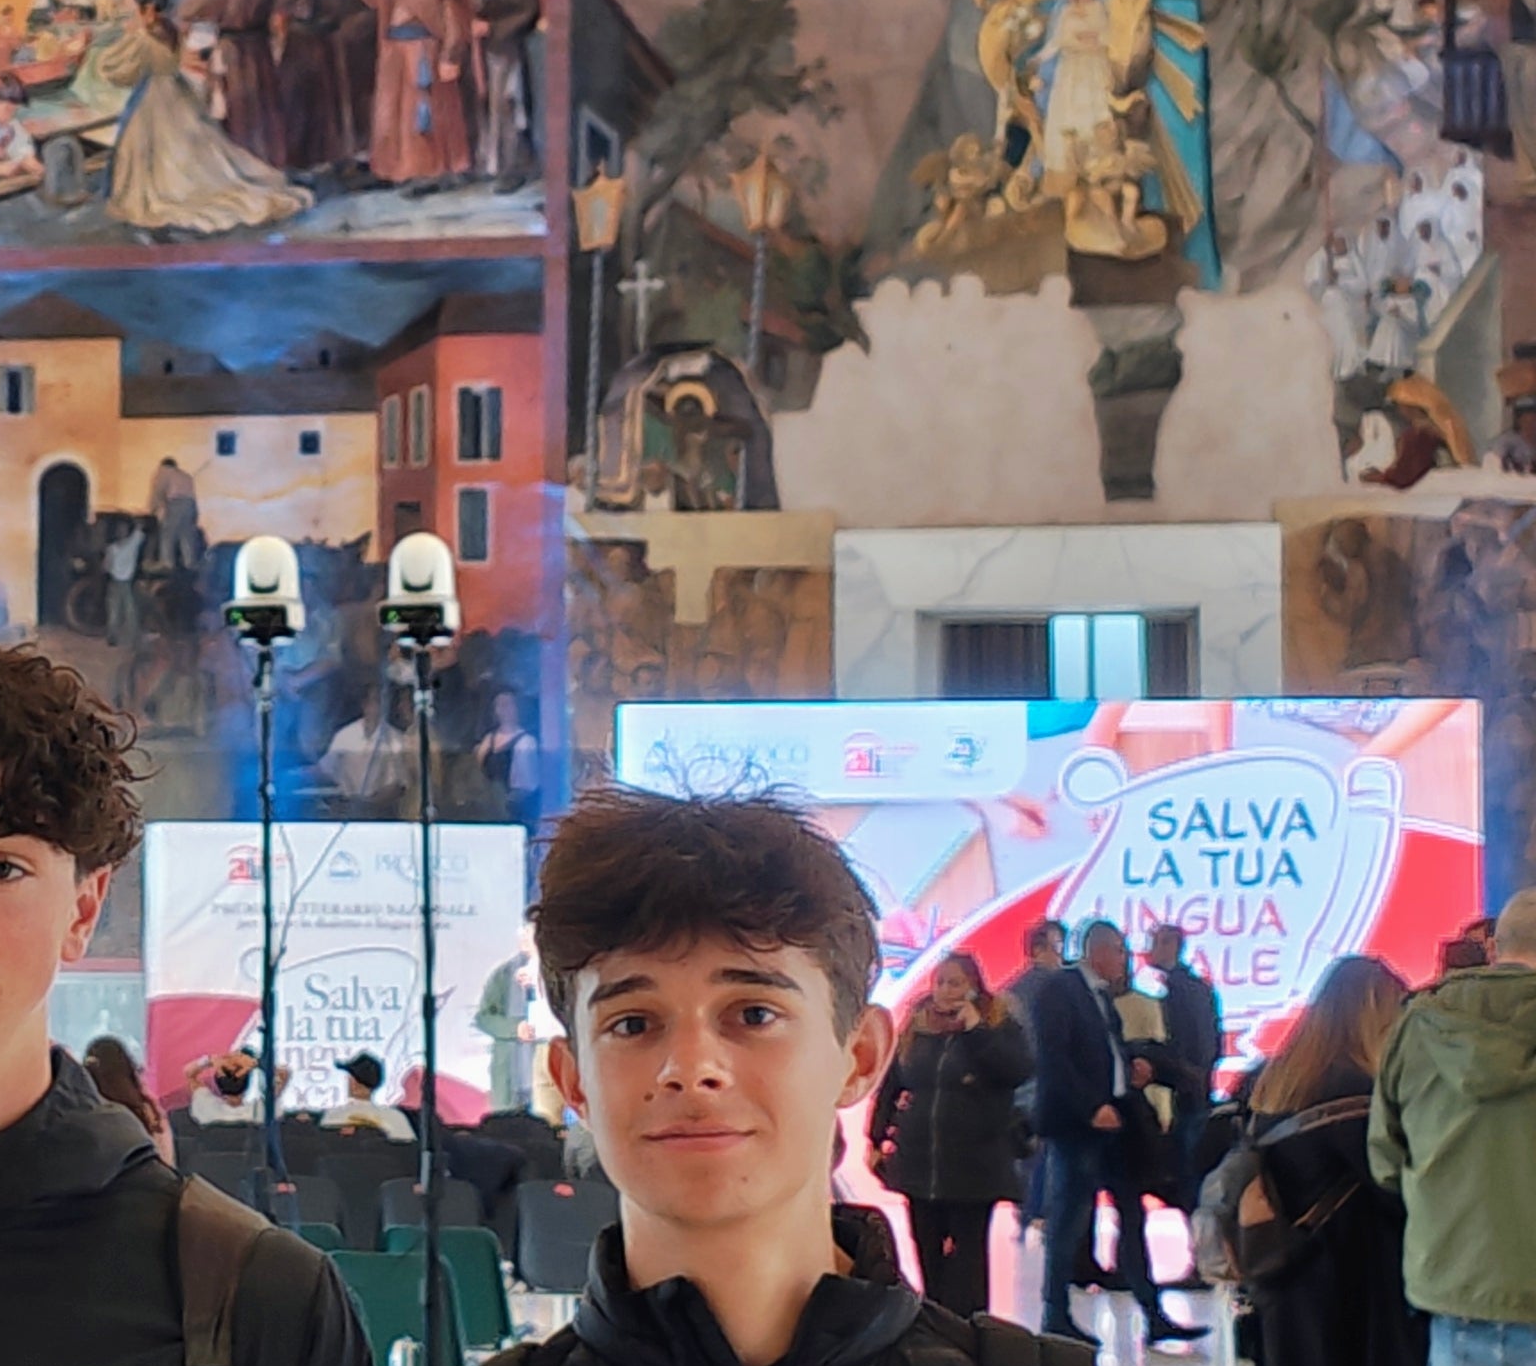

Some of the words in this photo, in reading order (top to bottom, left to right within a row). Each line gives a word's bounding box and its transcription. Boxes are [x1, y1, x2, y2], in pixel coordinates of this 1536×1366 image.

[1148, 797, 1316, 841] SALVA
[1122, 847, 1184, 887] LA
[1198, 847, 1303, 887] TUA
[303, 972, 402, 1011] Salva
[284, 1004, 318, 1042] la
[326, 1013, 385, 1042] tua
